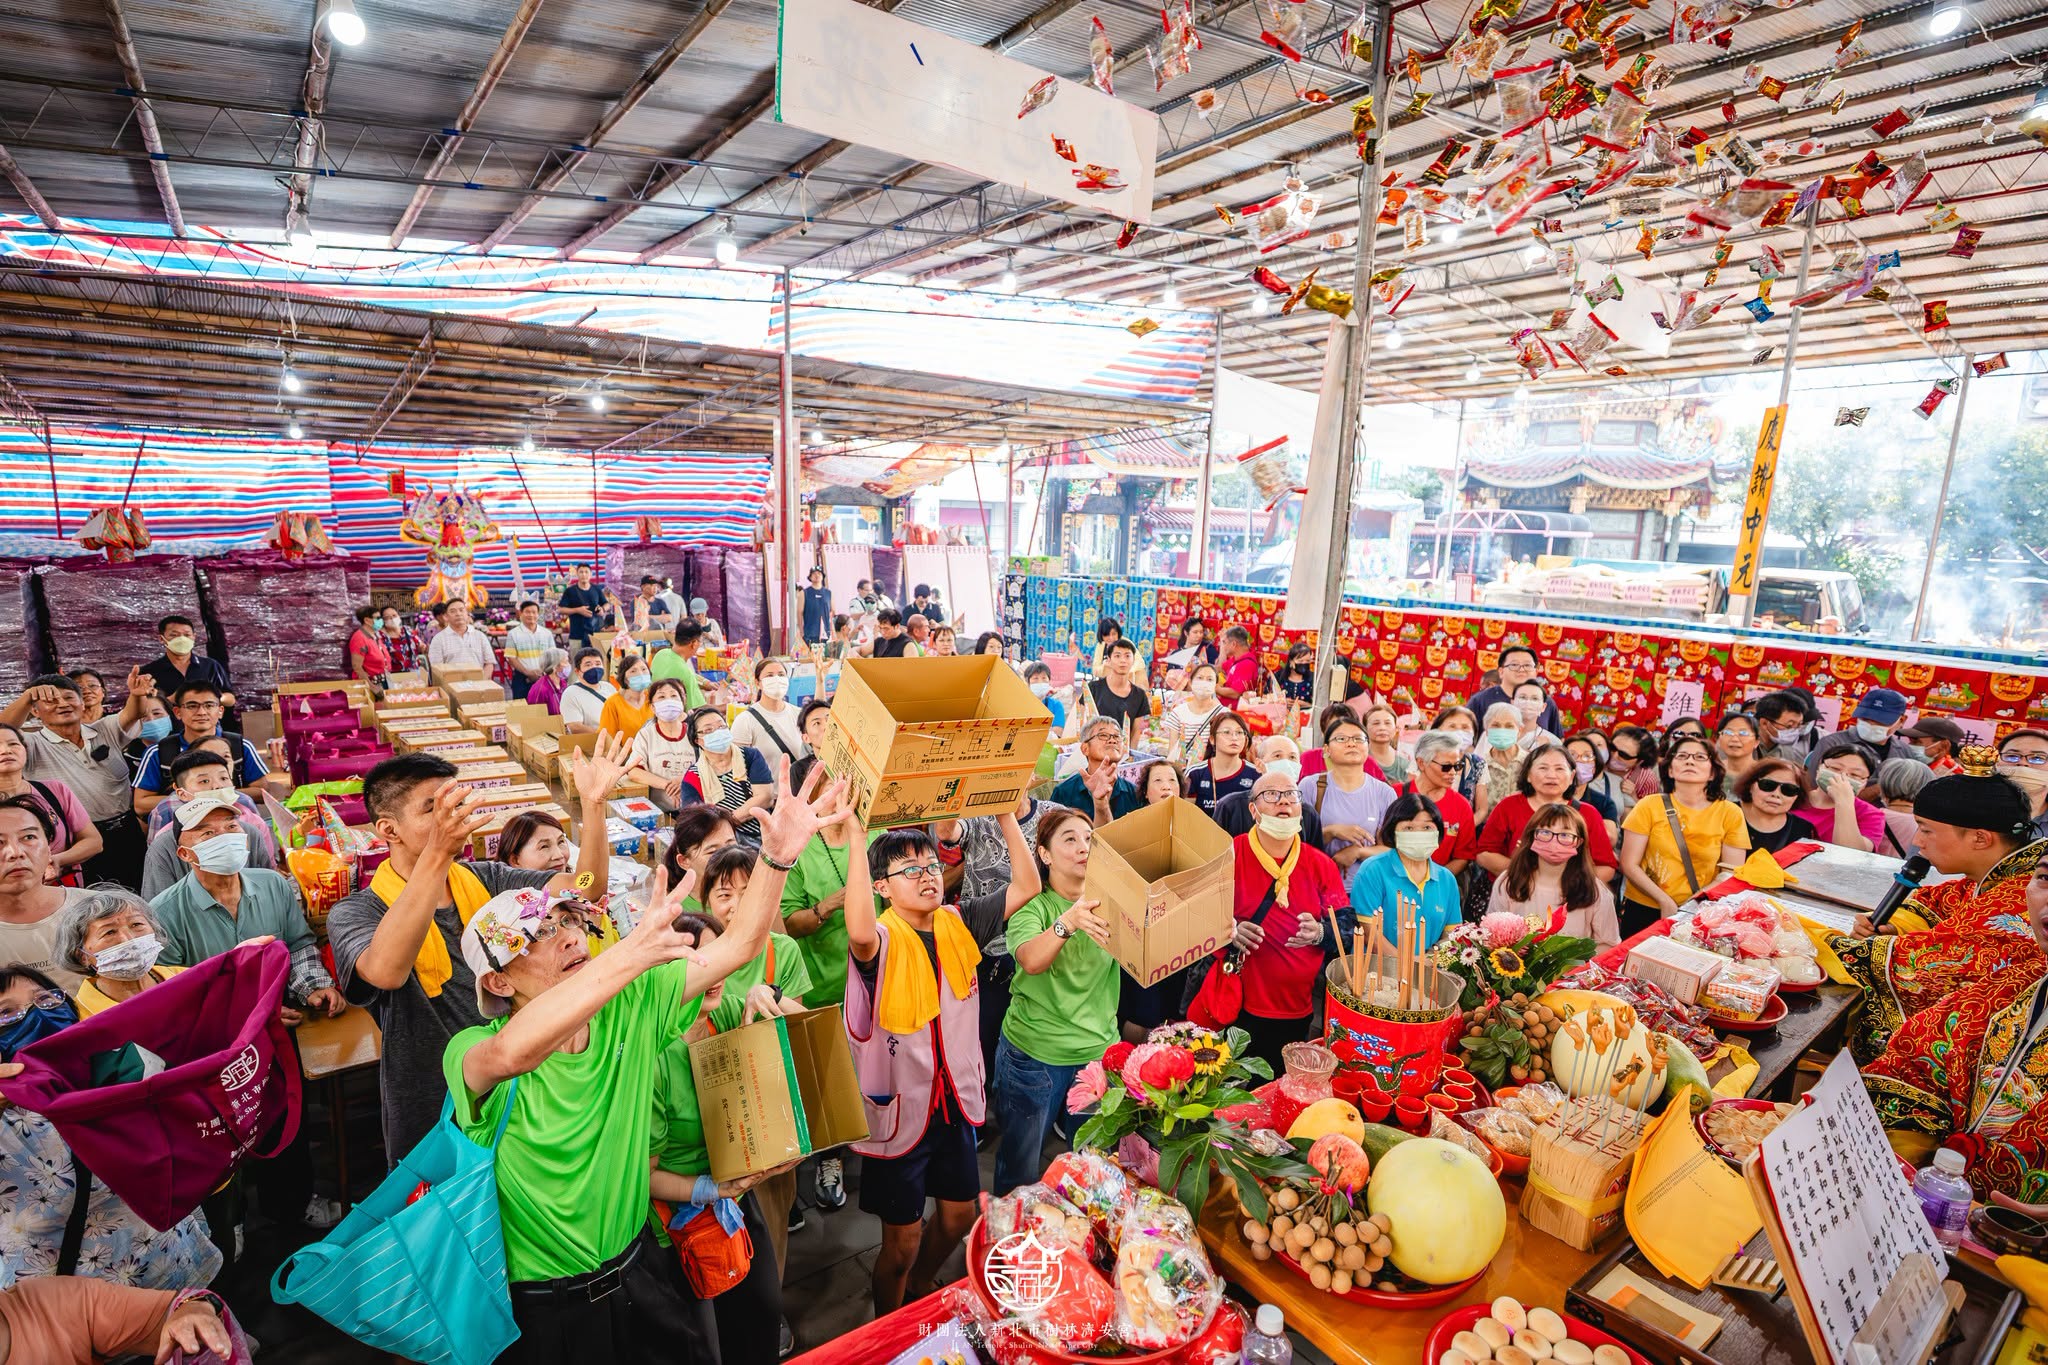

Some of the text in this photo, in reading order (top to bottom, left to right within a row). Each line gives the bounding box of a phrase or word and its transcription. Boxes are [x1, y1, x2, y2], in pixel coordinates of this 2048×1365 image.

[1667, 692, 1695, 716] 維
[579, 874, 591, 887] 勇
[1149, 936, 1217, 984] momo
